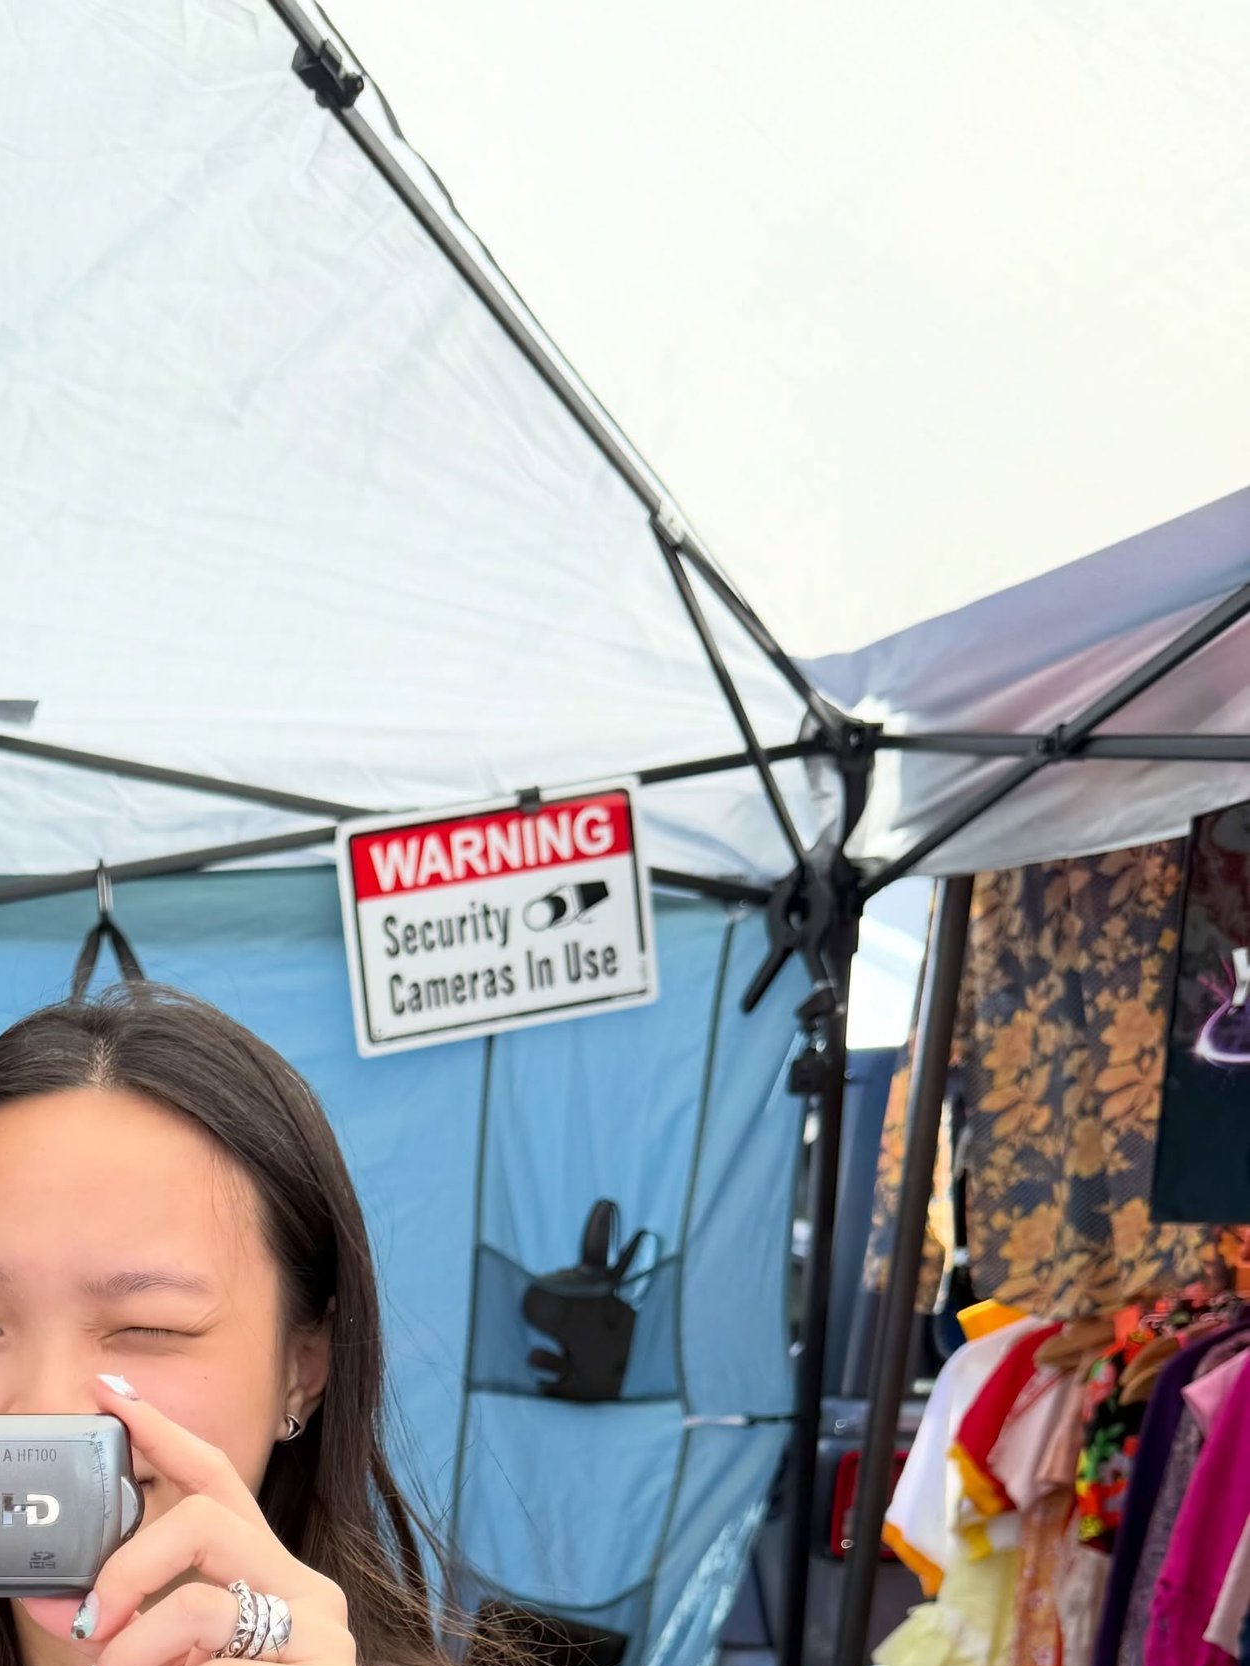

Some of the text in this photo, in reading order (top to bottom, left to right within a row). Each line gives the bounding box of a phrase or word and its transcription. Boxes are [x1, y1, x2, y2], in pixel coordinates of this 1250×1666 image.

[369, 806, 613, 892] WARNING
[383, 901, 509, 958] Security
[390, 963, 515, 1015] Cameras
[526, 949, 553, 991] In
[565, 942, 618, 983] Use
[17, 1448, 57, 1462] HF100
[2, 1493, 60, 1526] HD
